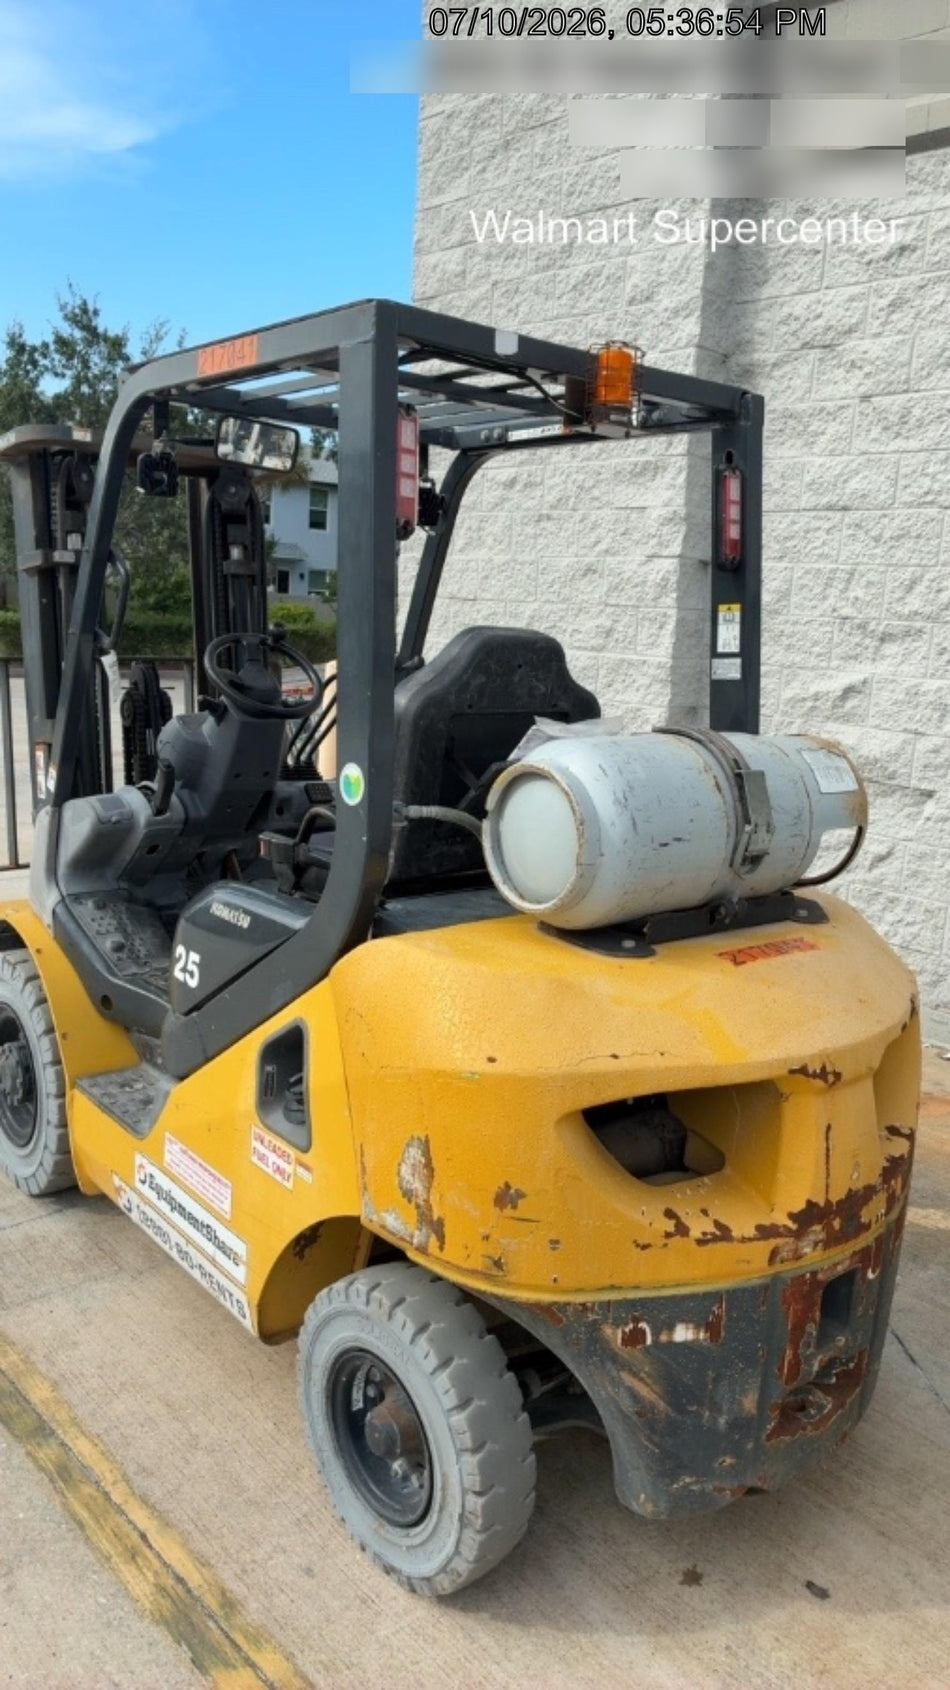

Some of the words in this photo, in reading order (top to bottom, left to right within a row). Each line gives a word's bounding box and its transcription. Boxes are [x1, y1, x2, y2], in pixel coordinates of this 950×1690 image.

[209, 901, 252, 929] KOMATSU
[173, 943, 201, 989] 25
[252, 1146, 270, 1169] FUEL
[253, 1129, 292, 1166] UNLEADED
[272, 1161, 292, 1184] ONLY
[148, 1172, 241, 1267] EquipmentShare
